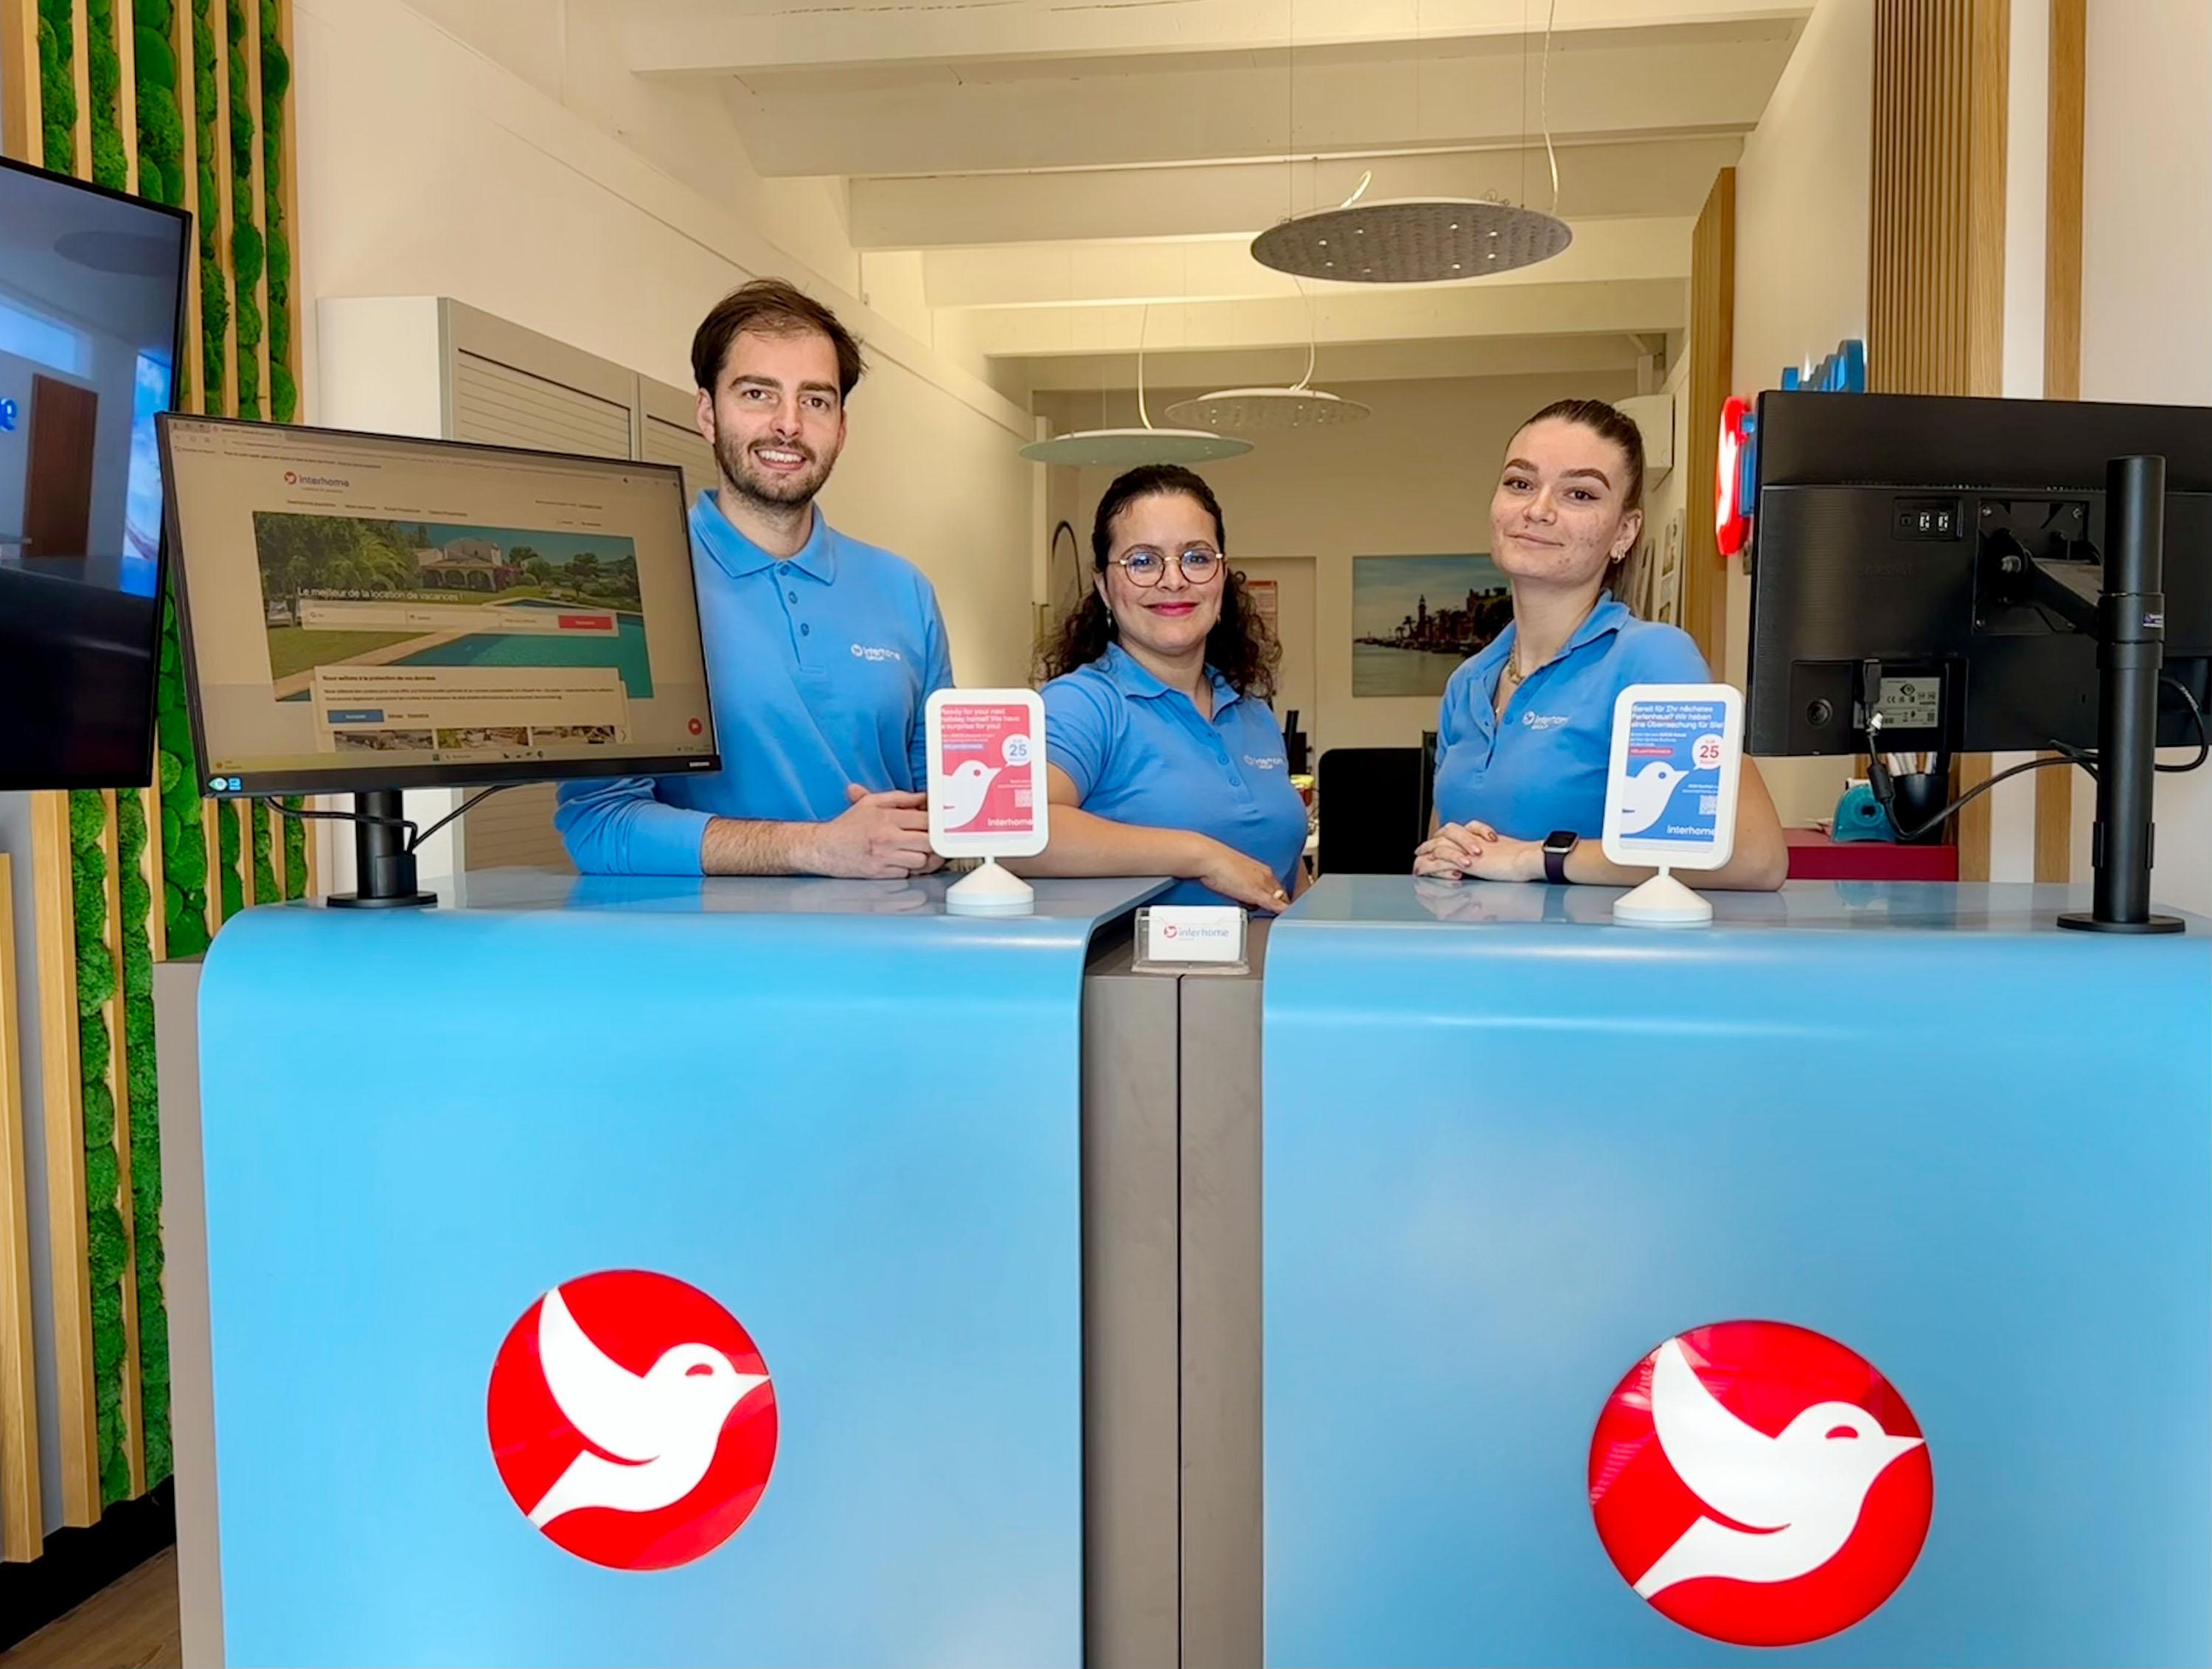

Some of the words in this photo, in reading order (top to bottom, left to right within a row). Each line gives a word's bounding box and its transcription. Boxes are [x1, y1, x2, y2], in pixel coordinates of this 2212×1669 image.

[297, 586, 310, 596] Le
[347, 589, 360, 597] de
[371, 589, 406, 599] location
[420, 592, 458, 601] vacances
[1009, 744, 1027, 757] 25
[1700, 745, 1719, 758] 25
